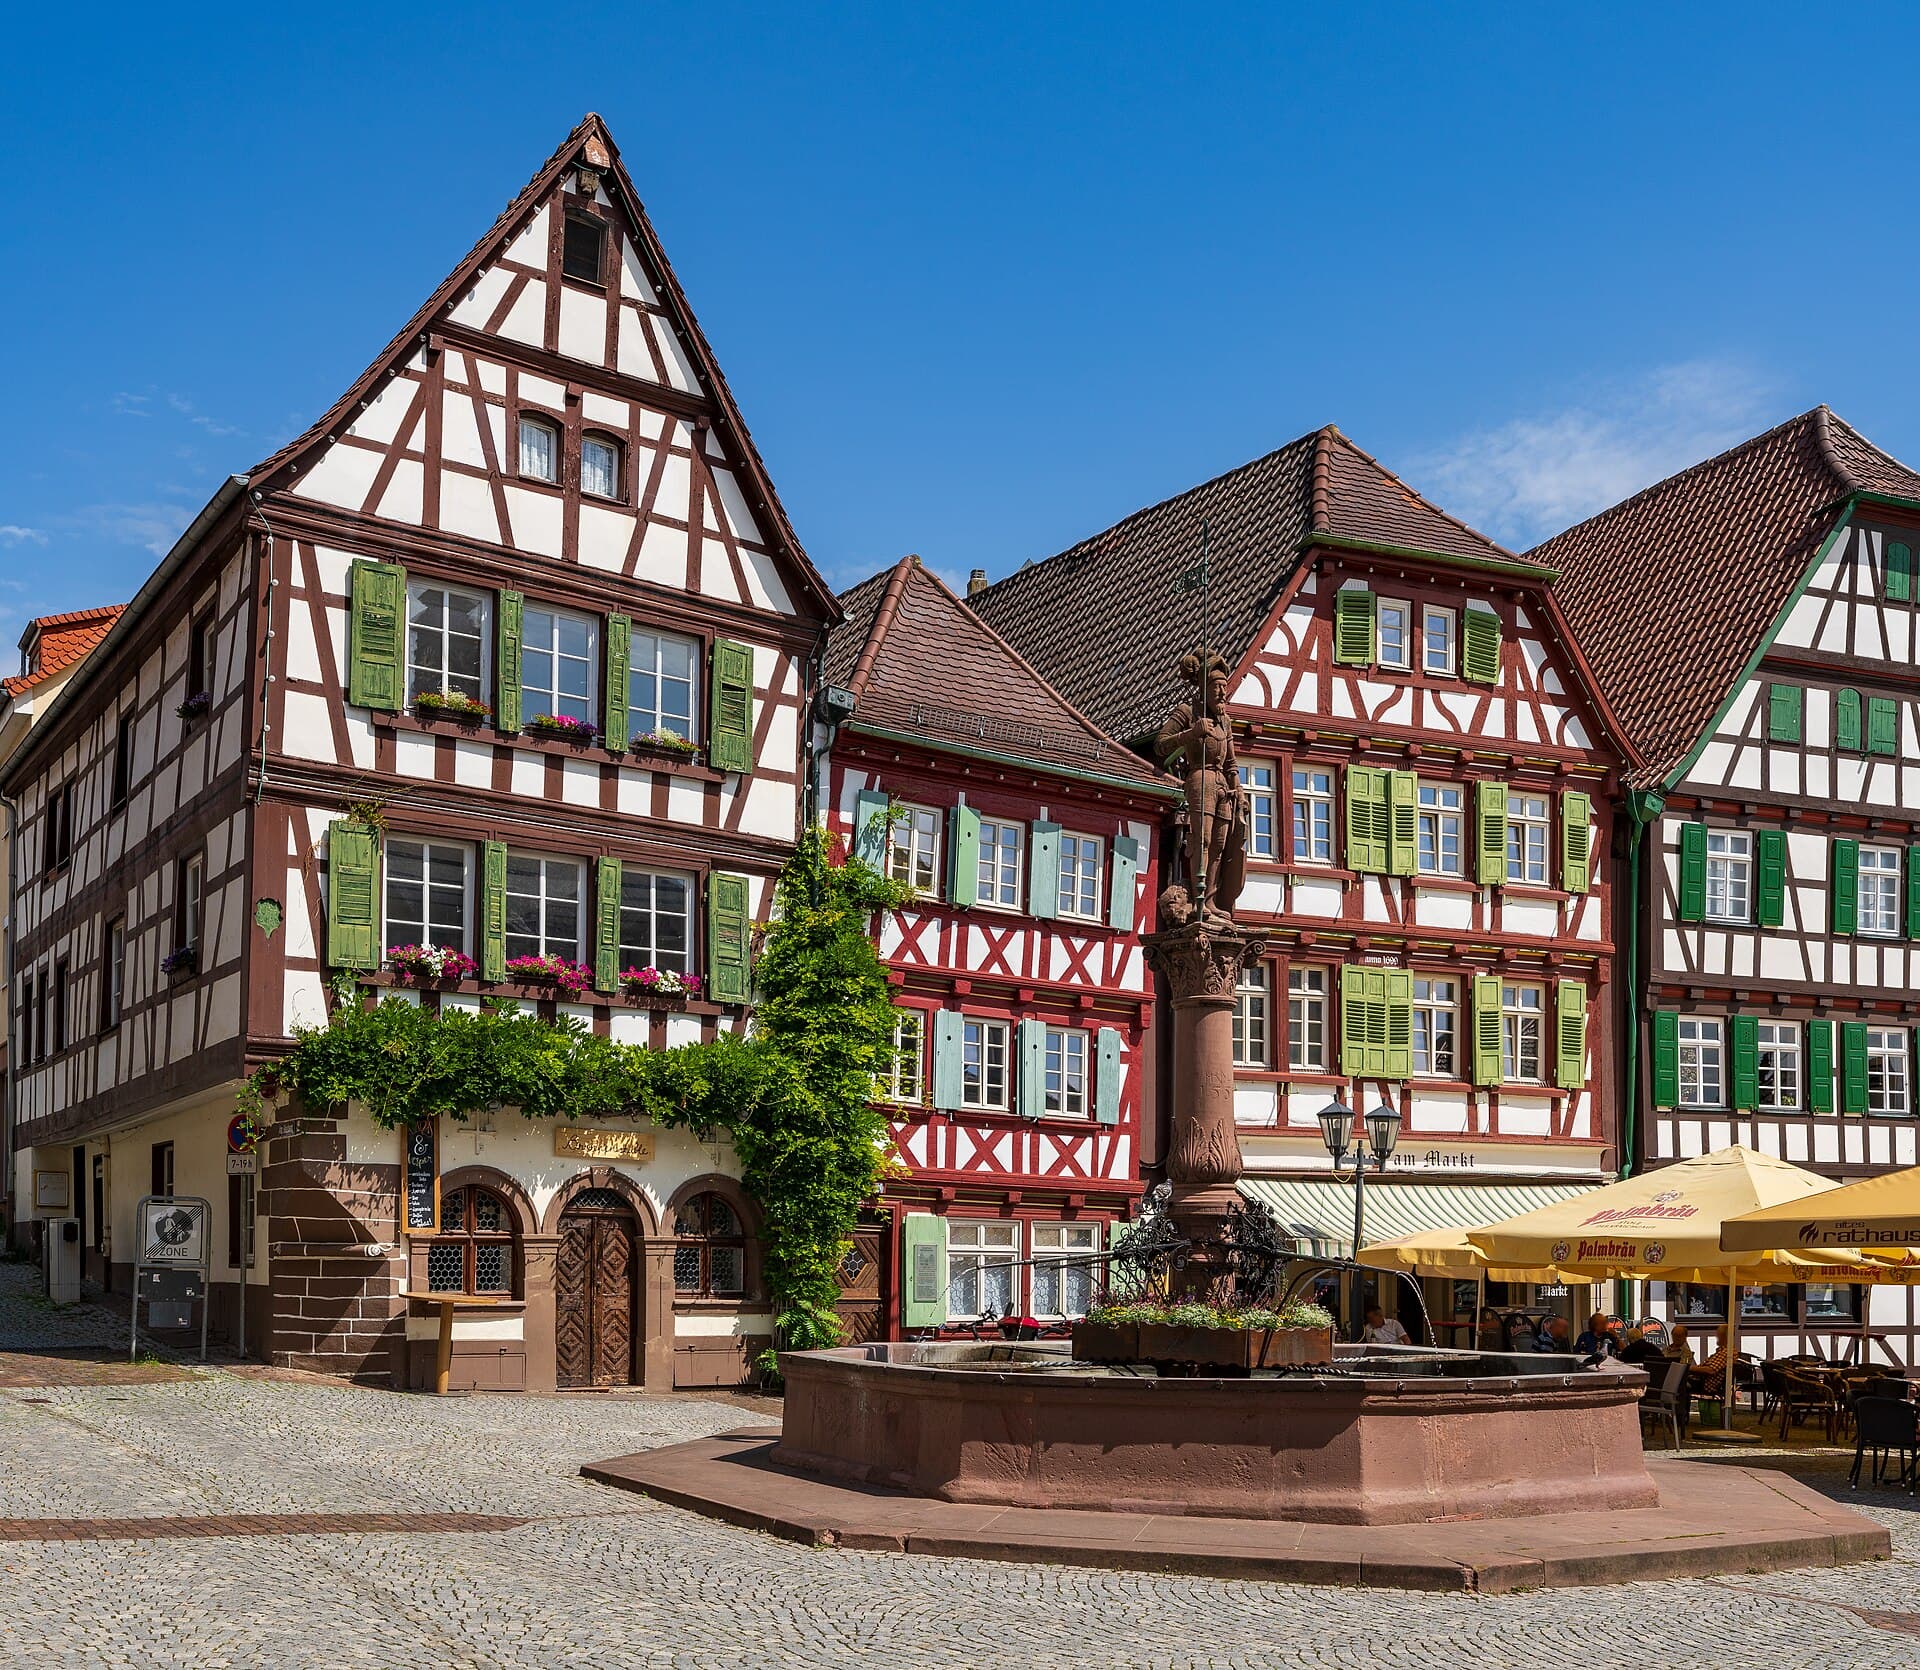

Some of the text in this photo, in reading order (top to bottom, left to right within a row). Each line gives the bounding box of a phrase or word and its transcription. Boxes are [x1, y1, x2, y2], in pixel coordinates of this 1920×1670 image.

[1393, 1153, 1416, 1167] am
[1424, 1150, 1475, 1168] Markt
[1578, 1203, 1699, 1227] Palmbräu
[1835, 1221, 1865, 1229] altes
[1823, 1229, 1920, 1243] rathaus
[160, 1247, 189, 1257] ZONE
[1577, 1239, 1637, 1262] Palmbräu
[1540, 1285, 1569, 1297] Markt
